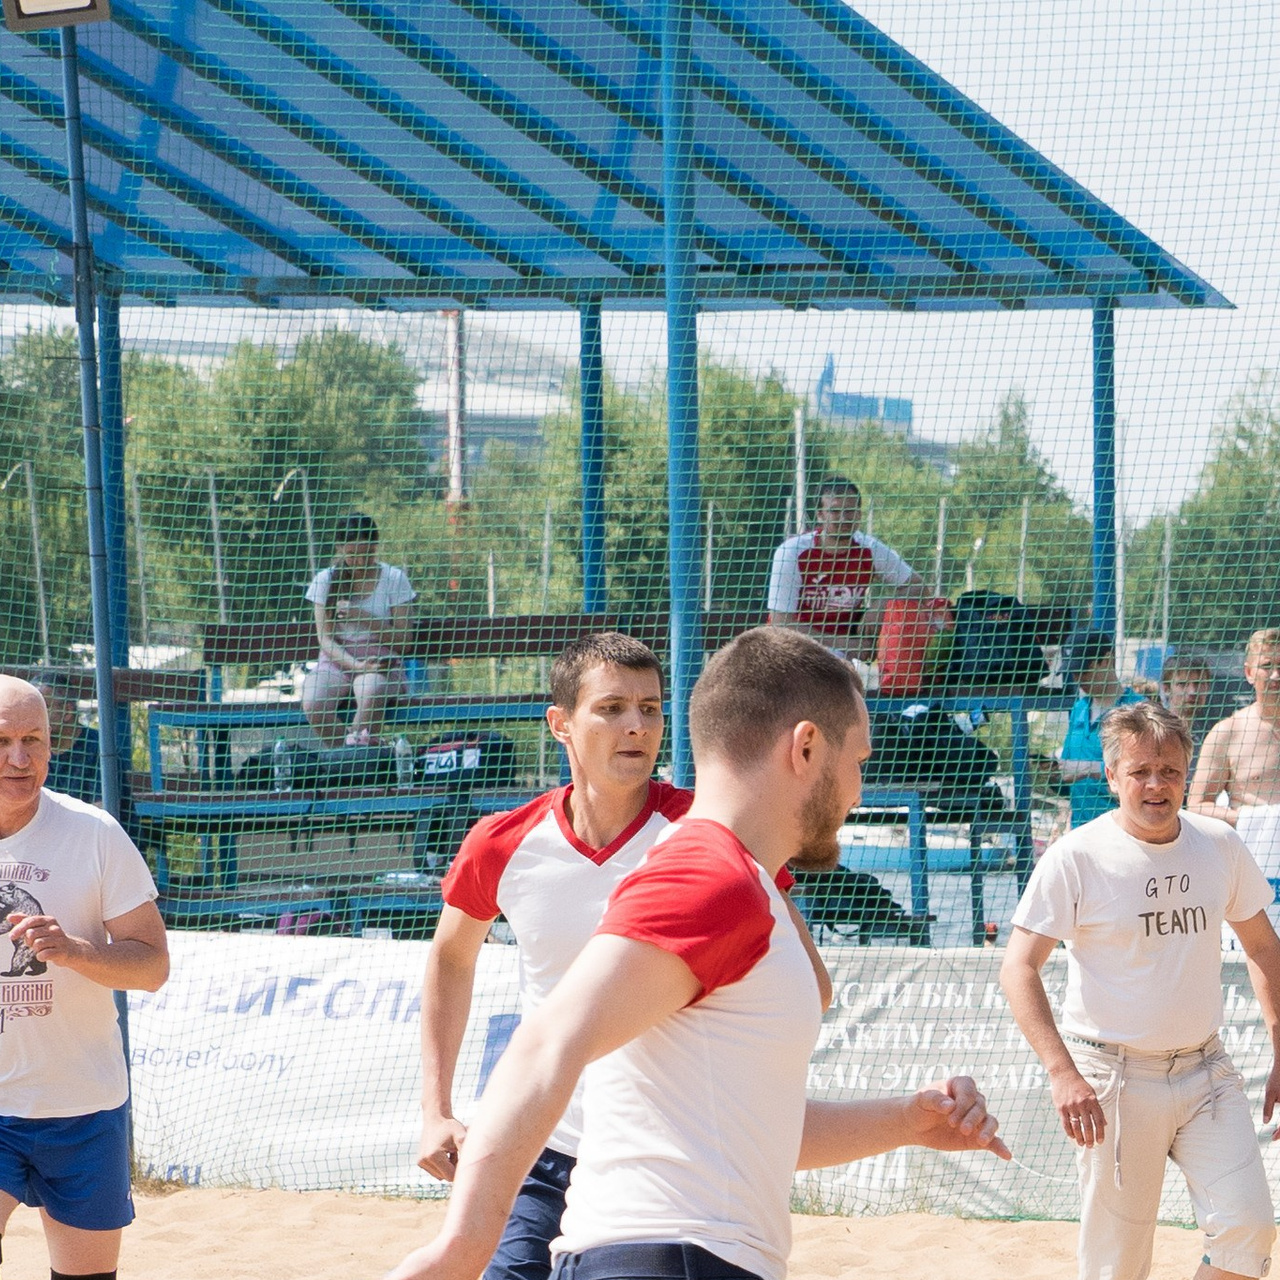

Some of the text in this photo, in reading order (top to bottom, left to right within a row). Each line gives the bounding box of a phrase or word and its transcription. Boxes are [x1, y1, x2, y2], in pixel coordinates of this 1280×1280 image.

[1145, 874, 1190, 898] GTO
[1138, 905, 1208, 937] TEAM
[920, 982, 974, 1008] БЫ
[940, 1022, 999, 1050] ЖЕ
[806, 1063, 871, 1089] КАК
